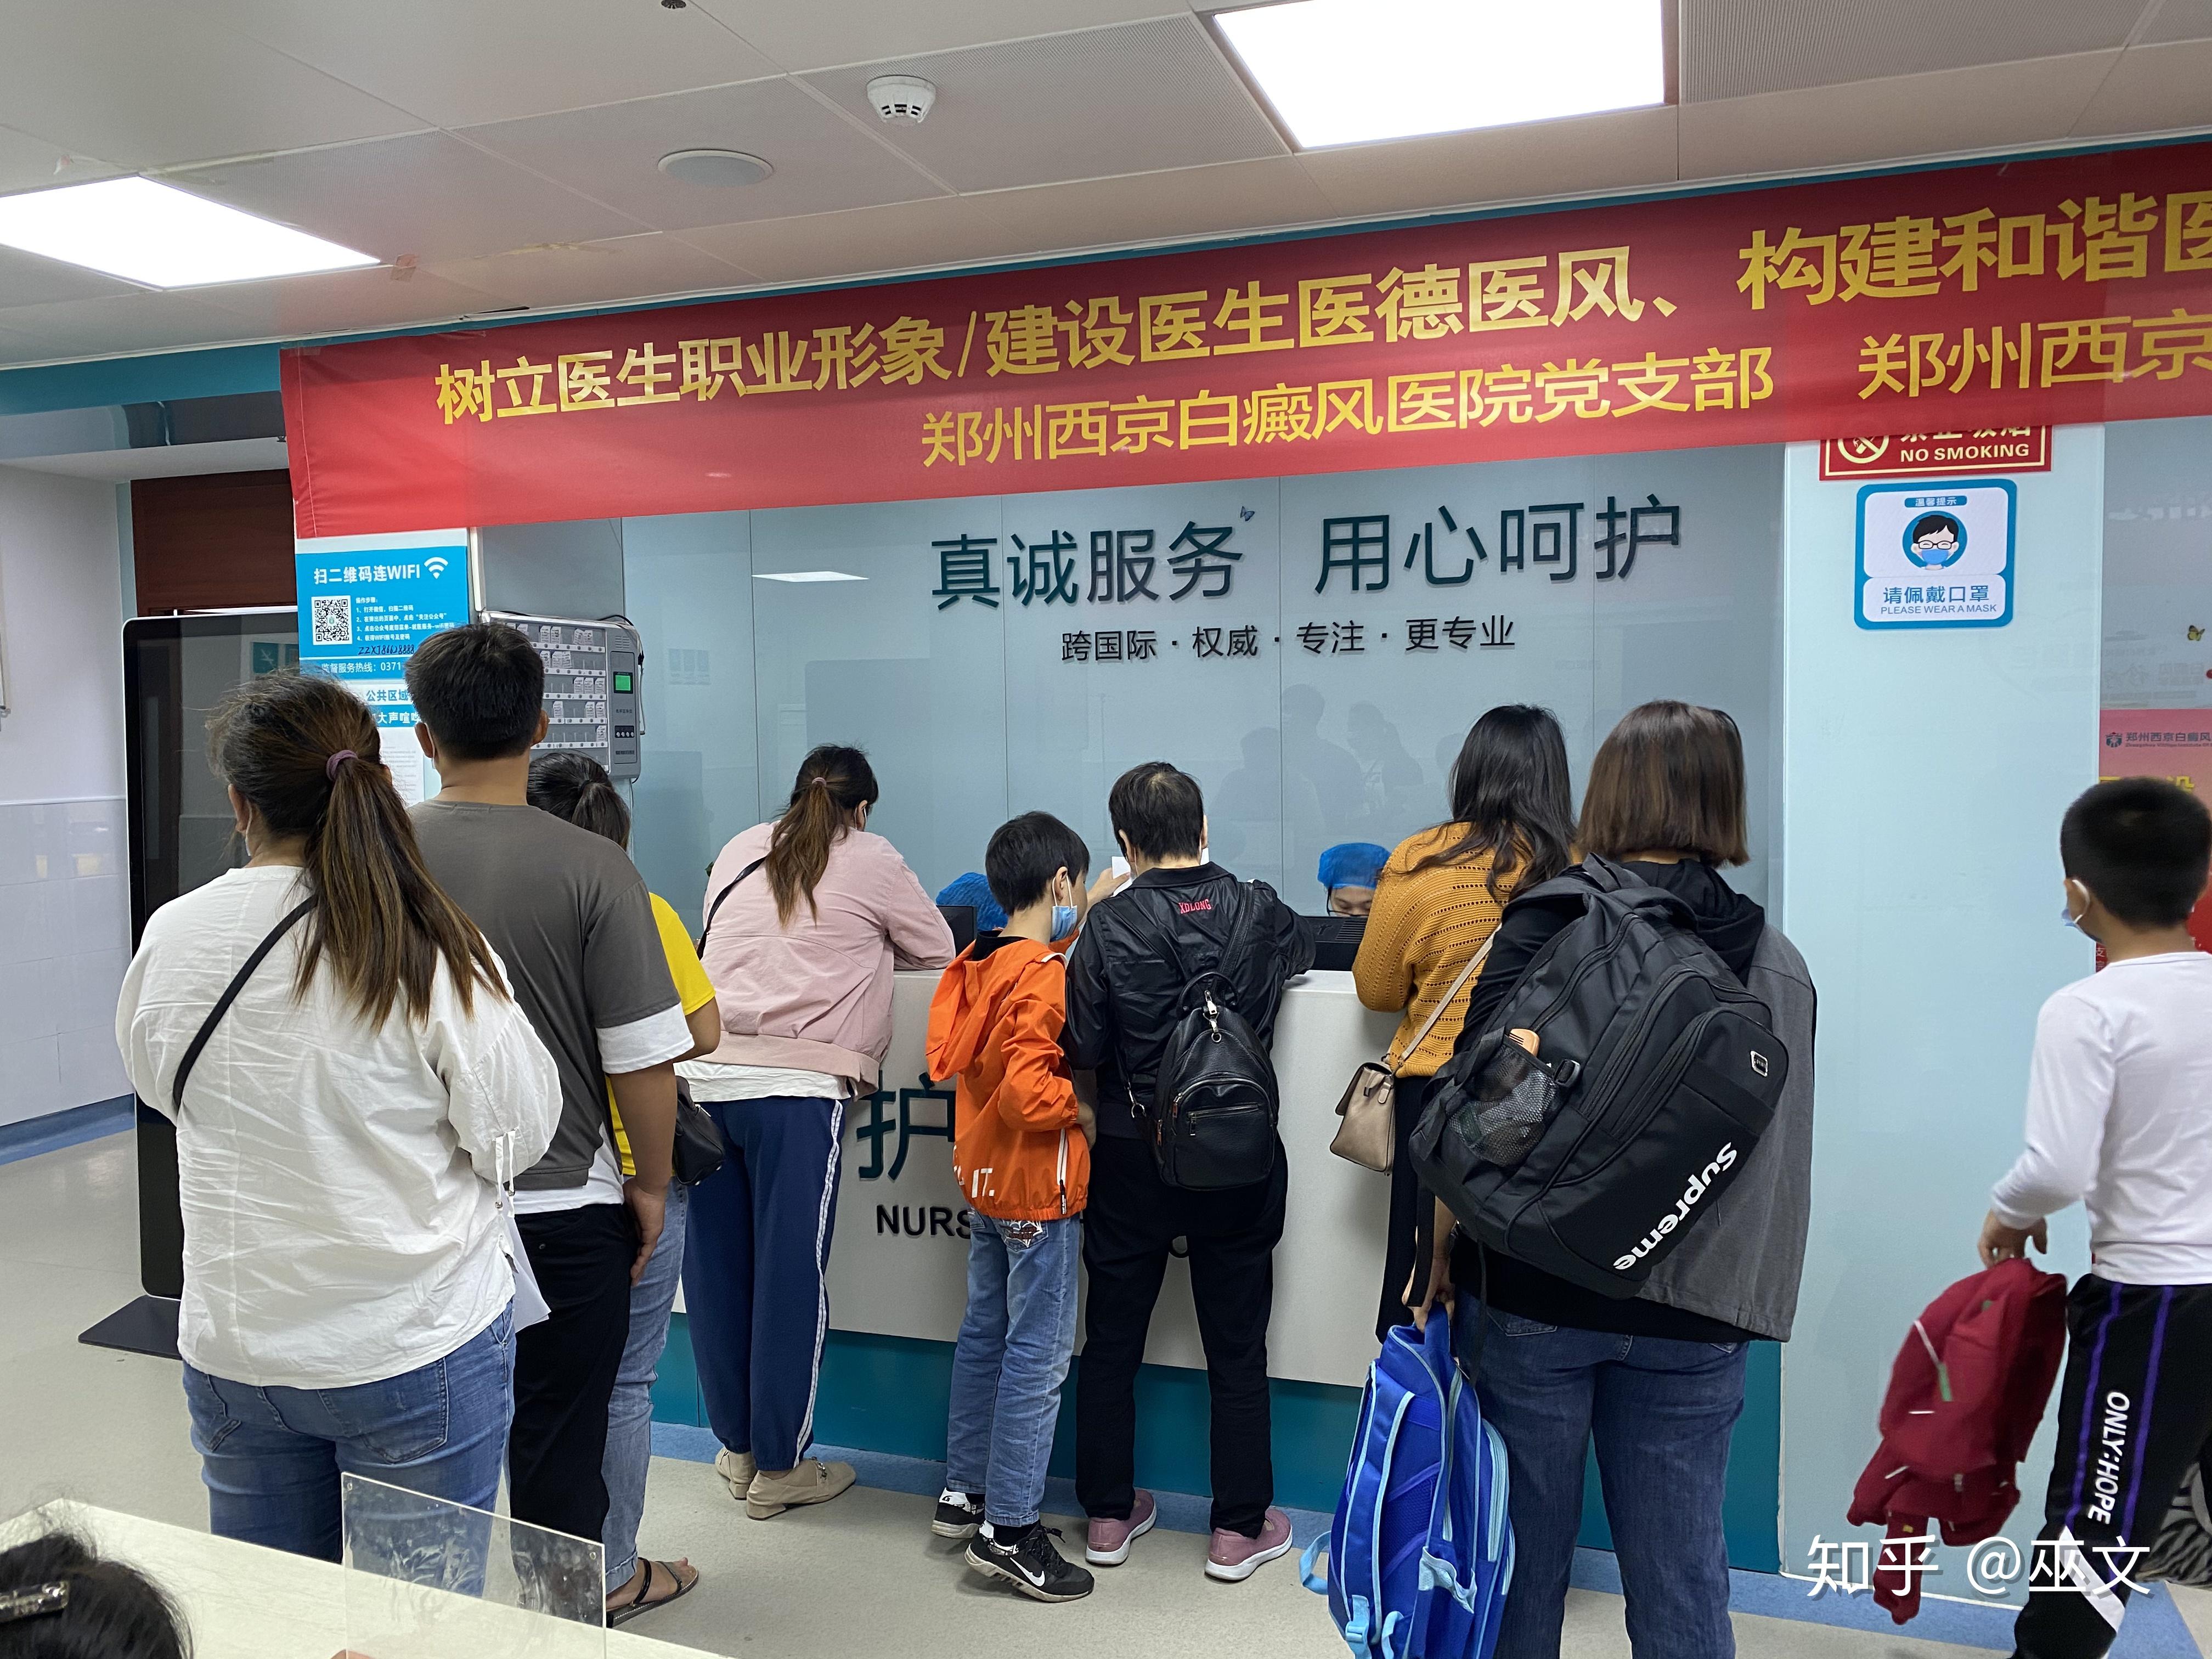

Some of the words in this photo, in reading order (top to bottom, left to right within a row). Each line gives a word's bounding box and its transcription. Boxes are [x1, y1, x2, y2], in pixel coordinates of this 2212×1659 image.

[922, 347, 1774, 467] 郑州西京白癜风医院党支部
[1858, 308, 2212, 399] 郑州西京
[1900, 449, 1929, 462] NO
[1934, 443, 2029, 461] SMOKING
[1915, 496, 1957, 507] 温馨提示
[931, 520, 1243, 609] 真诚服务
[1314, 495, 1681, 595] 用心呵护
[314, 564, 420, 585] 扫二维码连WIFI
[1883, 585, 1989, 604] 请佩戴口罩
[1881, 606, 1921, 614] PLEASE
[1924, 605, 1955, 613] WEAR
[1967, 603, 1997, 612] MASK
[366, 689, 408, 702] 公共区域
[1178, 899, 1211, 914] XDLONG
[856, 1072, 956, 1181] 护
[1613, 1142, 1737, 1270] Supreme
